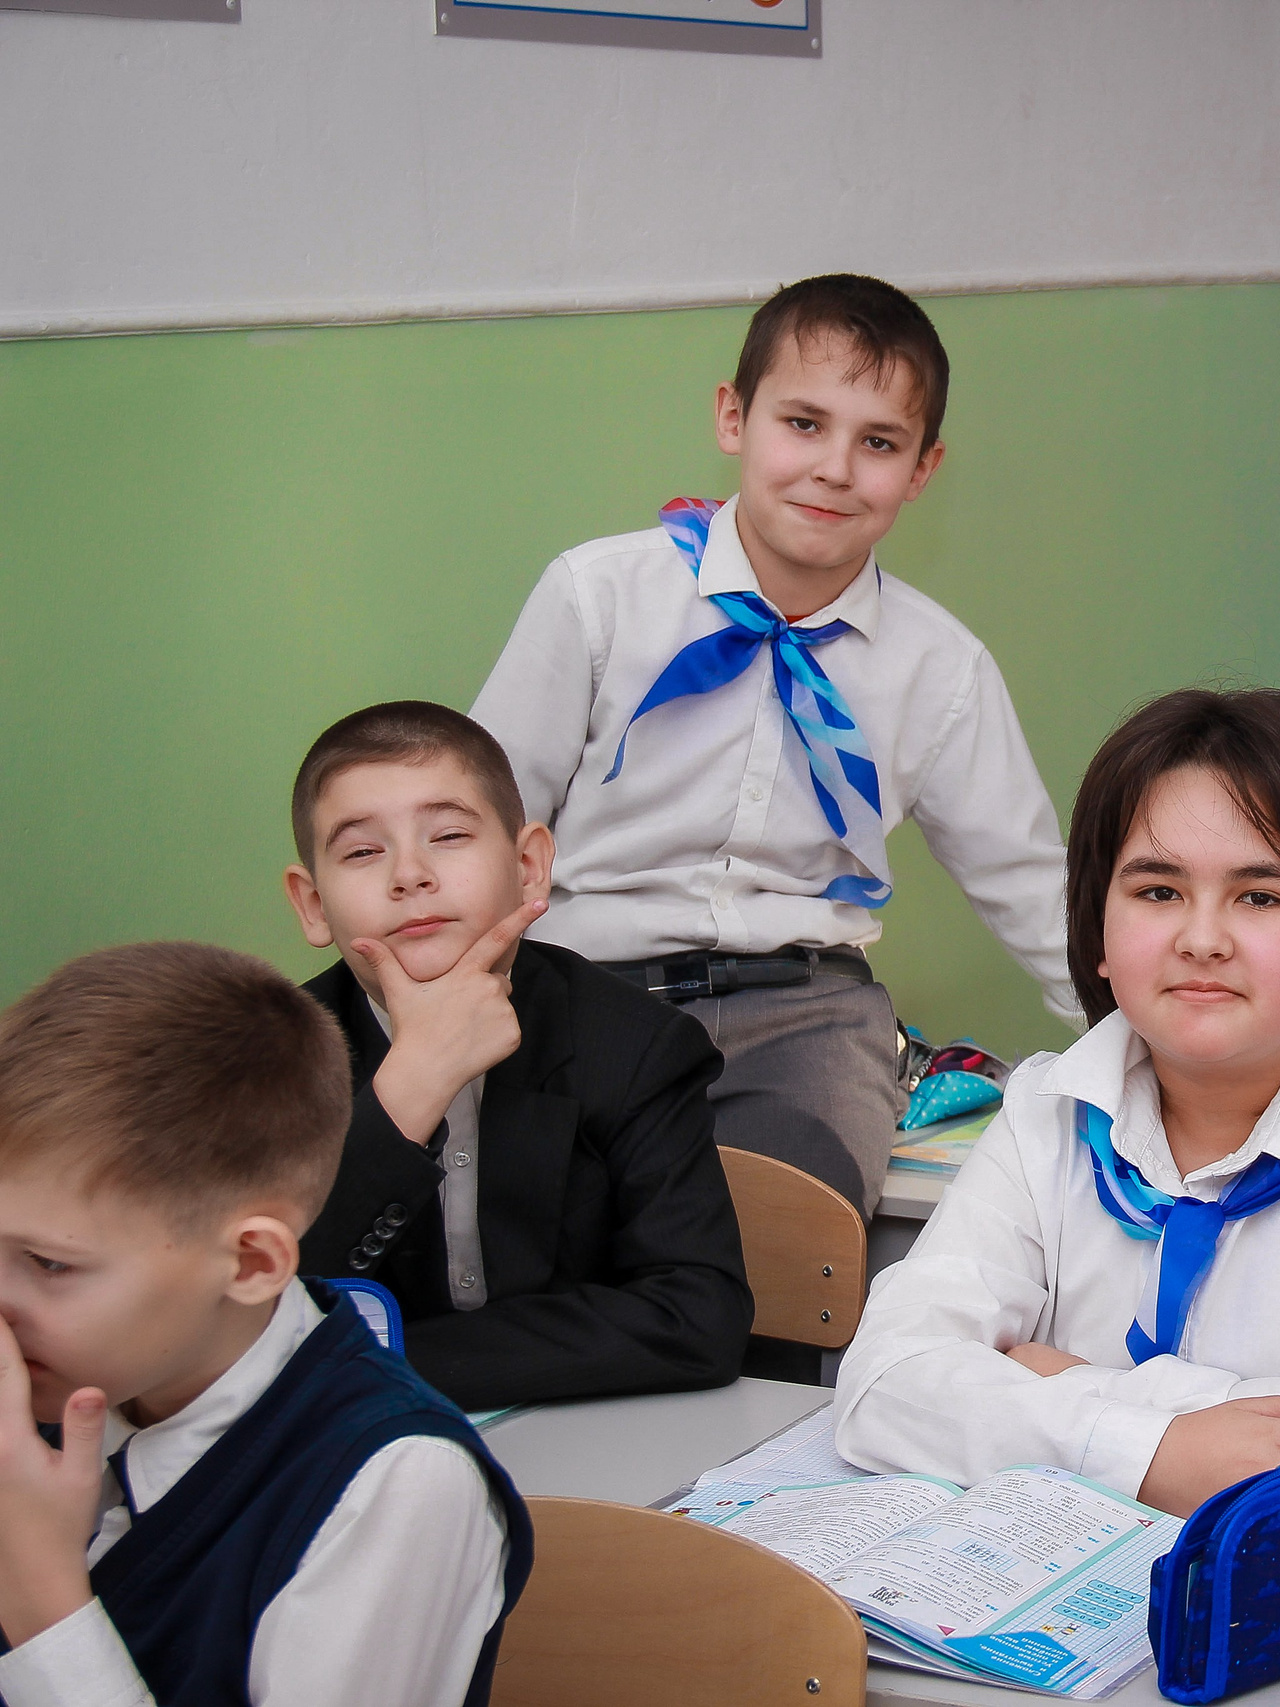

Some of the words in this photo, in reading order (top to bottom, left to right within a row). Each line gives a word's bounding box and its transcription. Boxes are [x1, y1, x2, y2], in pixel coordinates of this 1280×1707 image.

[980, 1644, 1033, 1667] вычитание.
[989, 1635, 1048, 1660] письменные
[1021, 1637, 1068, 1656] числений
[1025, 1644, 1063, 1659] приёмы
[991, 1655, 1041, 1676] Сложение
[1017, 1653, 1052, 1668] Устные
